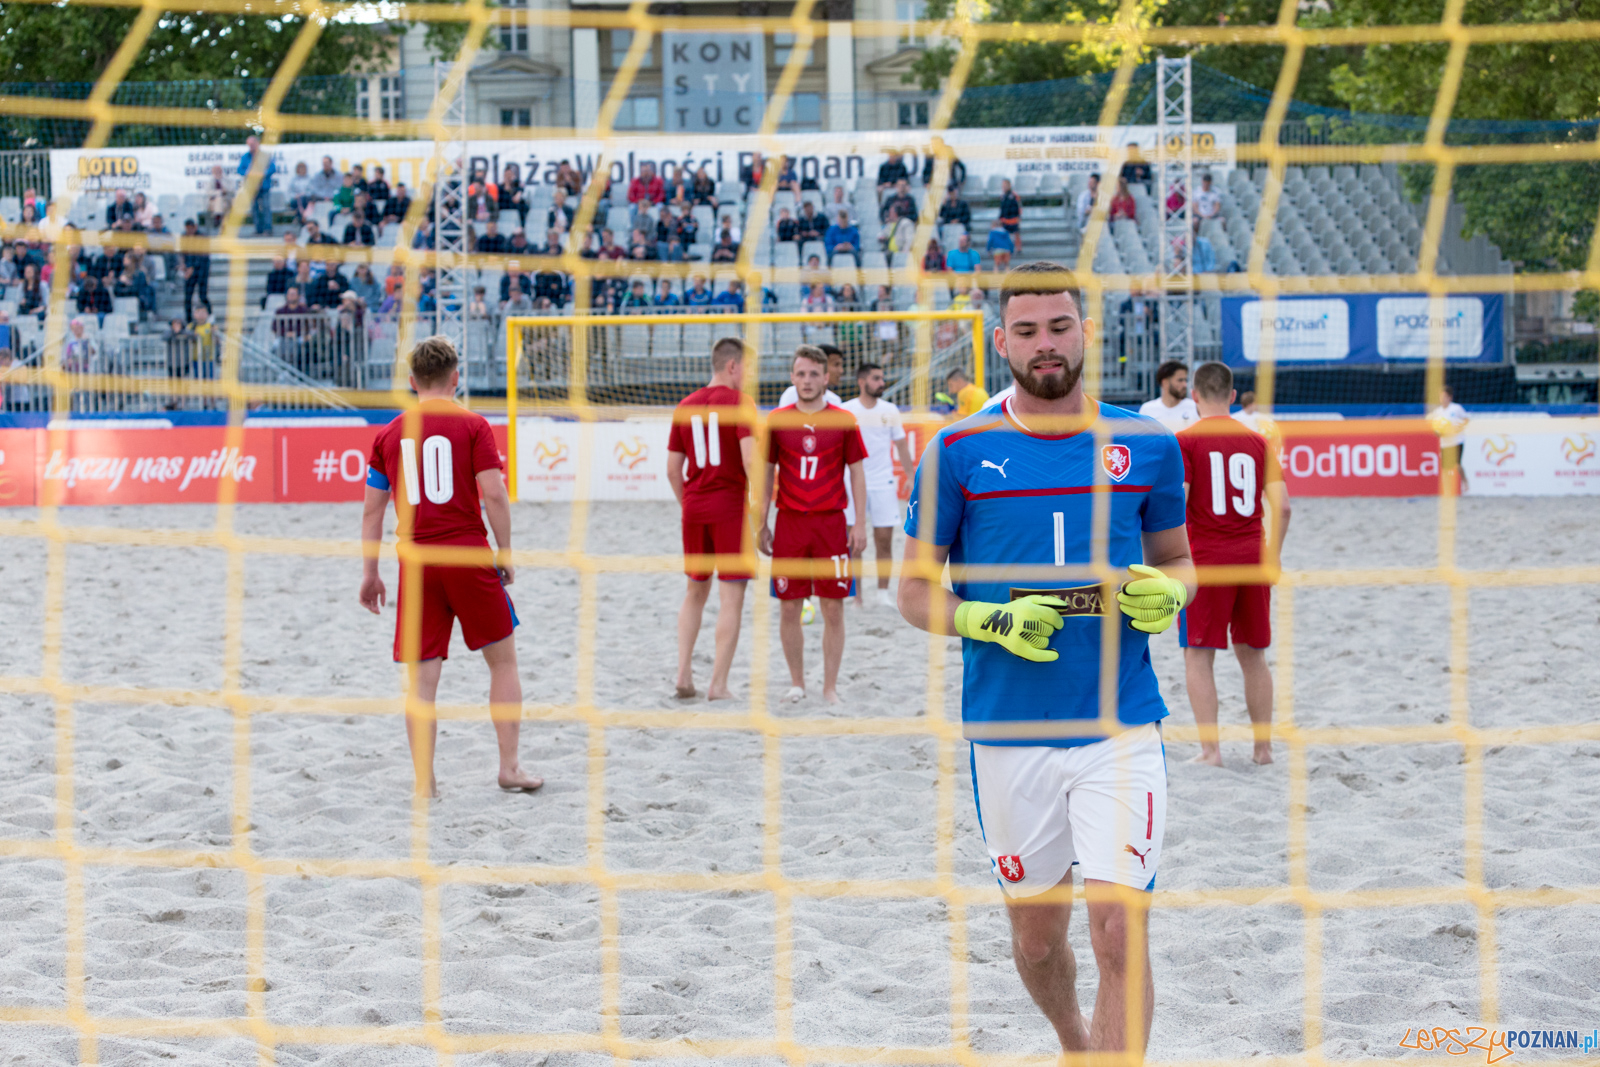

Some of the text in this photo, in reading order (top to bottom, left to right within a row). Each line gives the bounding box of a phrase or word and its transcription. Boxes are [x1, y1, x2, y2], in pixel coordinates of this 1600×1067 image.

[672, 41, 752, 63] KON
[674, 73, 751, 96] STY
[675, 106, 752, 128] TUC
[78, 156, 138, 177] LOTTO
[691, 412, 720, 469] 11
[131, 456, 184, 483] nas
[178, 447, 257, 492] piłka
[401, 435, 454, 505] 10
[800, 456, 818, 480] 17
[1274, 444, 1439, 477] #Od100La
[1209, 451, 1256, 517] 19
[1053, 512, 1065, 566] 1
[831, 553, 849, 578] 17
